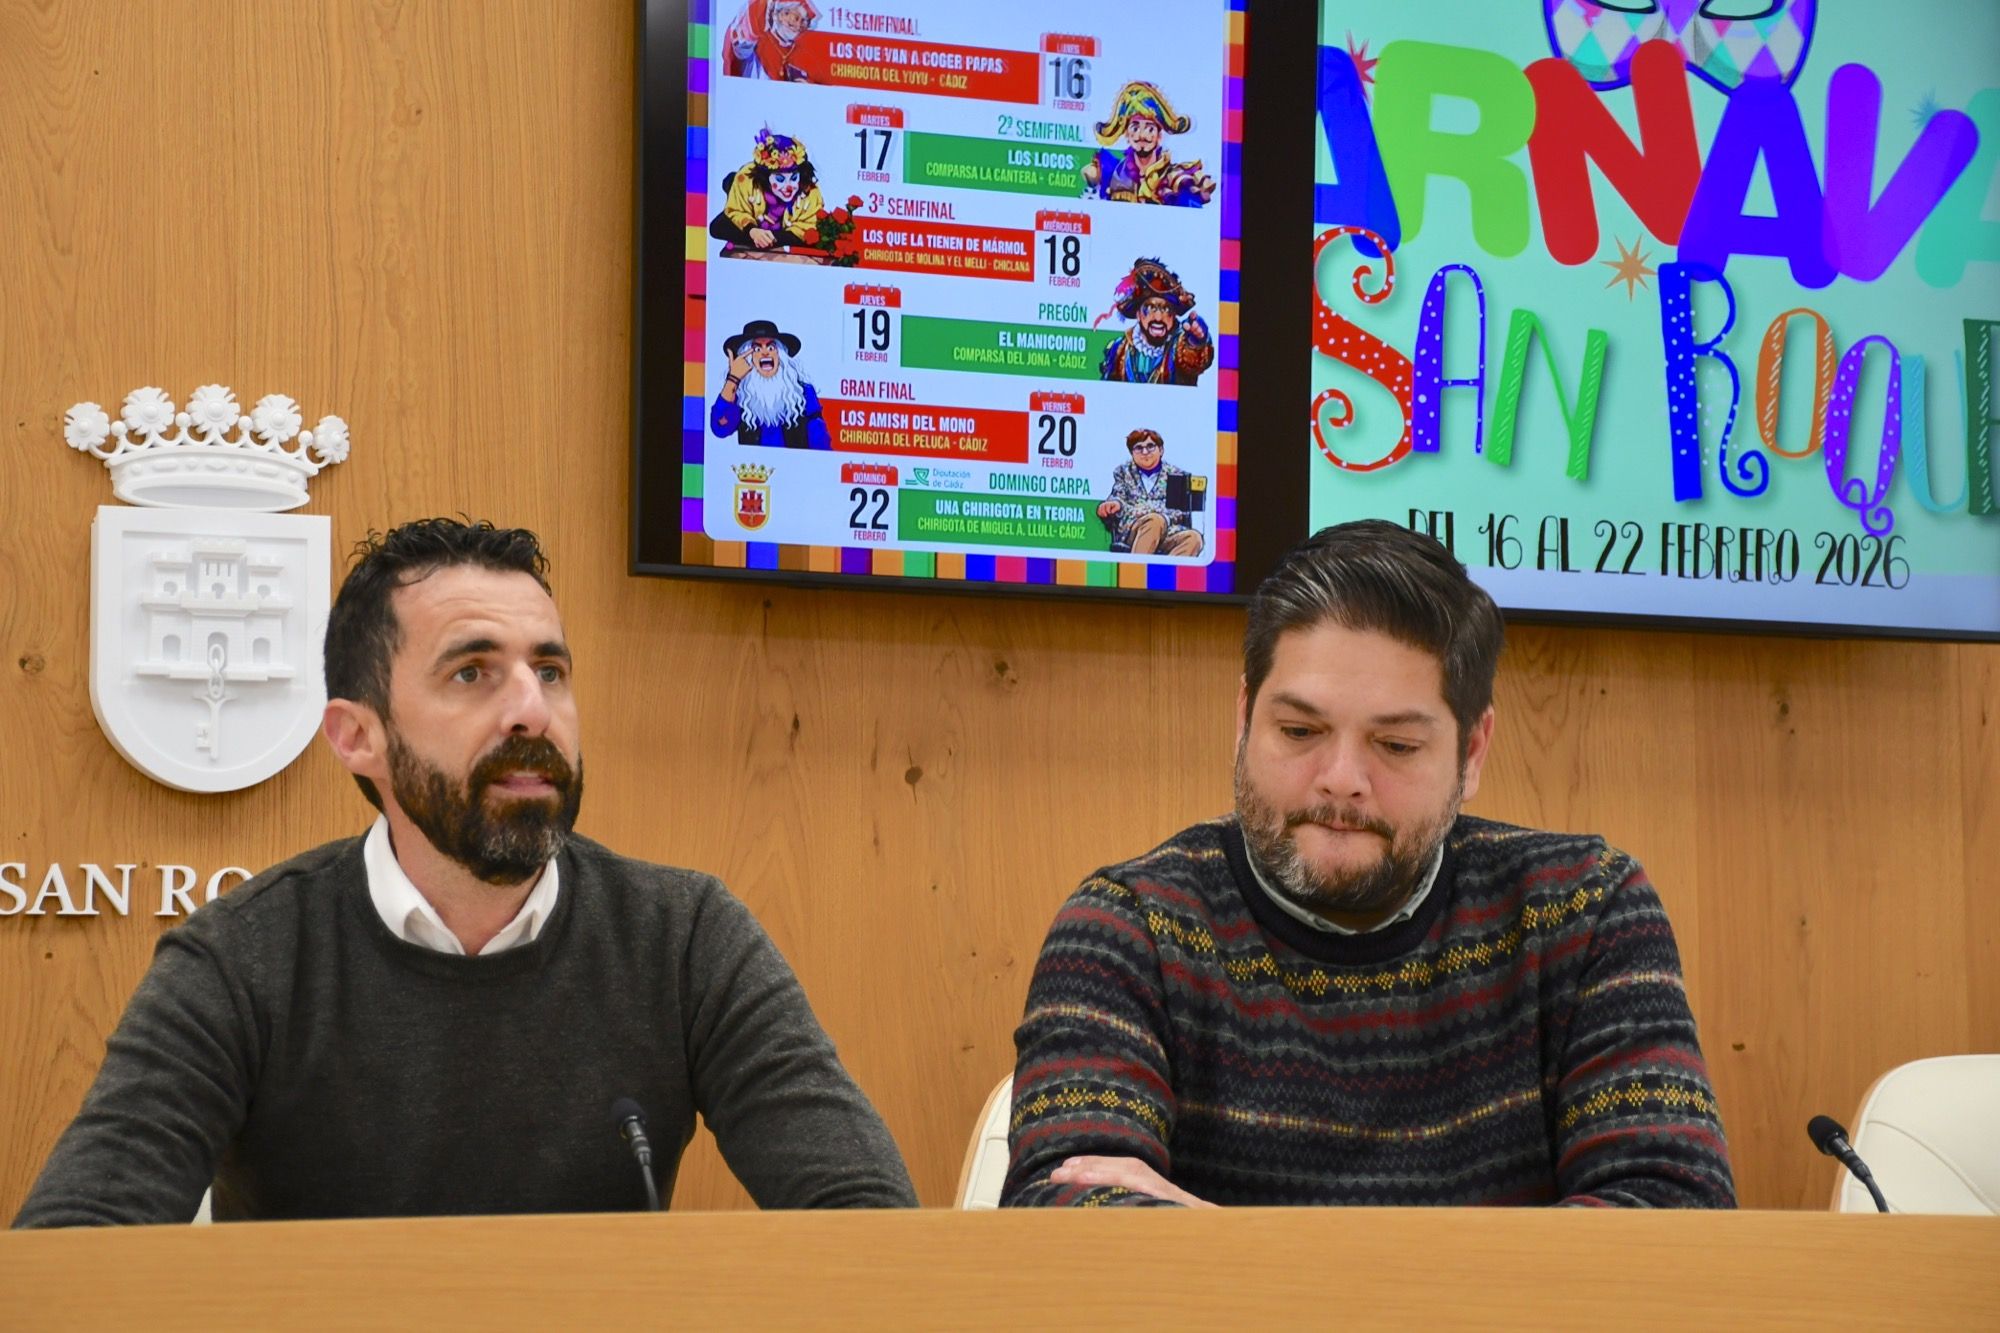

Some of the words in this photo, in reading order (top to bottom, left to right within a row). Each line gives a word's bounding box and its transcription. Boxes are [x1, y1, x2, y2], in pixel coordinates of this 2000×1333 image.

[830, 42, 853, 58] LOS
[856, 44, 881, 62] QUE
[884, 47, 907, 64] VAN
[911, 50, 919, 65] A
[922, 51, 961, 70] COGER
[966, 57, 1006, 74] PAPAS
[830, 63, 881, 81] CHIRIGOTA
[883, 67, 900, 82] DEL
[903, 70, 928, 86] YUYU
[1049, 56, 1091, 100] 16
[860, 114, 890, 126] MARTES
[1016, 121, 1083, 142] SEMIFINAL
[854, 128, 892, 170] 17
[1008, 149, 1031, 167] LOS
[1034, 151, 1074, 169] LOCOS
[926, 162, 977, 180] COMPARSA
[980, 167, 992, 181] LA
[994, 168, 1037, 185] CANTERA
[1048, 170, 1077, 187] CÁDIZ
[1314, 38, 2000, 290] ARNAVA
[857, 170, 890, 183] FEBRERO
[888, 197, 956, 220] SEMIFINAL
[1043, 219, 1082, 233] MIÉRCOLES
[863, 229, 884, 243] LOS
[886, 231, 907, 246] QUE
[910, 233, 924, 247] LA
[926, 234, 964, 251] TIENEN
[966, 237, 979, 252] DE
[982, 236, 1027, 256] MÁRMOL
[863, 249, 903, 263] CHIRIGOTA
[904, 252, 915, 264] DE
[917, 252, 944, 266] MOLINA
[946, 254, 952, 266] Y
[953, 255, 963, 268] EL
[964, 255, 987, 269] MELLI
[993, 257, 1030, 272] CHICLANA
[1043, 234, 1081, 276] 18
[1049, 276, 1081, 288] FEBRERO
[859, 294, 886, 306] JUEVES
[1038, 302, 1088, 323] PREGÓN
[853, 308, 890, 351] 19
[999, 331, 1014, 347] EL
[1017, 332, 1086, 352] MANICOMIO
[1312, 225, 1608, 481] SAN
[855, 350, 888, 363] FEBRERO
[953, 347, 1005, 363] COMPARSA
[1007, 350, 1025, 365] DEL
[1026, 351, 1050, 366] JONA
[1058, 351, 1087, 369] CÁDIZ
[840, 379, 875, 398] GRAN
[879, 382, 916, 401] FINAL
[1042, 401, 1072, 413] VIERNES
[841, 410, 865, 426] LOS
[869, 412, 909, 430] AMISH
[912, 415, 935, 432] DEL
[939, 417, 975, 434] MONO
[840, 430, 891, 447] CHIRIGOTA
[893, 434, 911, 448] DEL
[913, 435, 950, 450] PELUCA
[959, 433, 988, 452] CÁDIZ
[1038, 414, 1077, 457] 20
[1042, 457, 1074, 469] FEBRERO
[853, 472, 887, 485] DOMINGO
[989, 472, 1047, 493] DOMINGO
[1050, 477, 1091, 496] CARPA
[850, 488, 889, 530] 22
[935, 499, 959, 515] UNA
[962, 501, 1023, 520] CHIRIGOTA
[1026, 506, 1041, 520] EN
[1044, 507, 1085, 523] TEORIA
[853, 530, 886, 542] FEBRERO
[918, 517, 965, 533] CHIRIGOTA
[967, 520, 979, 533] DE
[981, 520, 1014, 535] MIGUEL
[1059, 521, 1086, 540] CÁDIZ
[1478, 512, 1523, 570] 16
[1536, 515, 1581, 573] AL
[1594, 519, 1646, 576] 22
[1661, 522, 1799, 584] FEBRERO
[1814, 531, 1910, 590] 2026
[0, 862, 137, 916] SAN
[154, 864, 253, 916] RO
